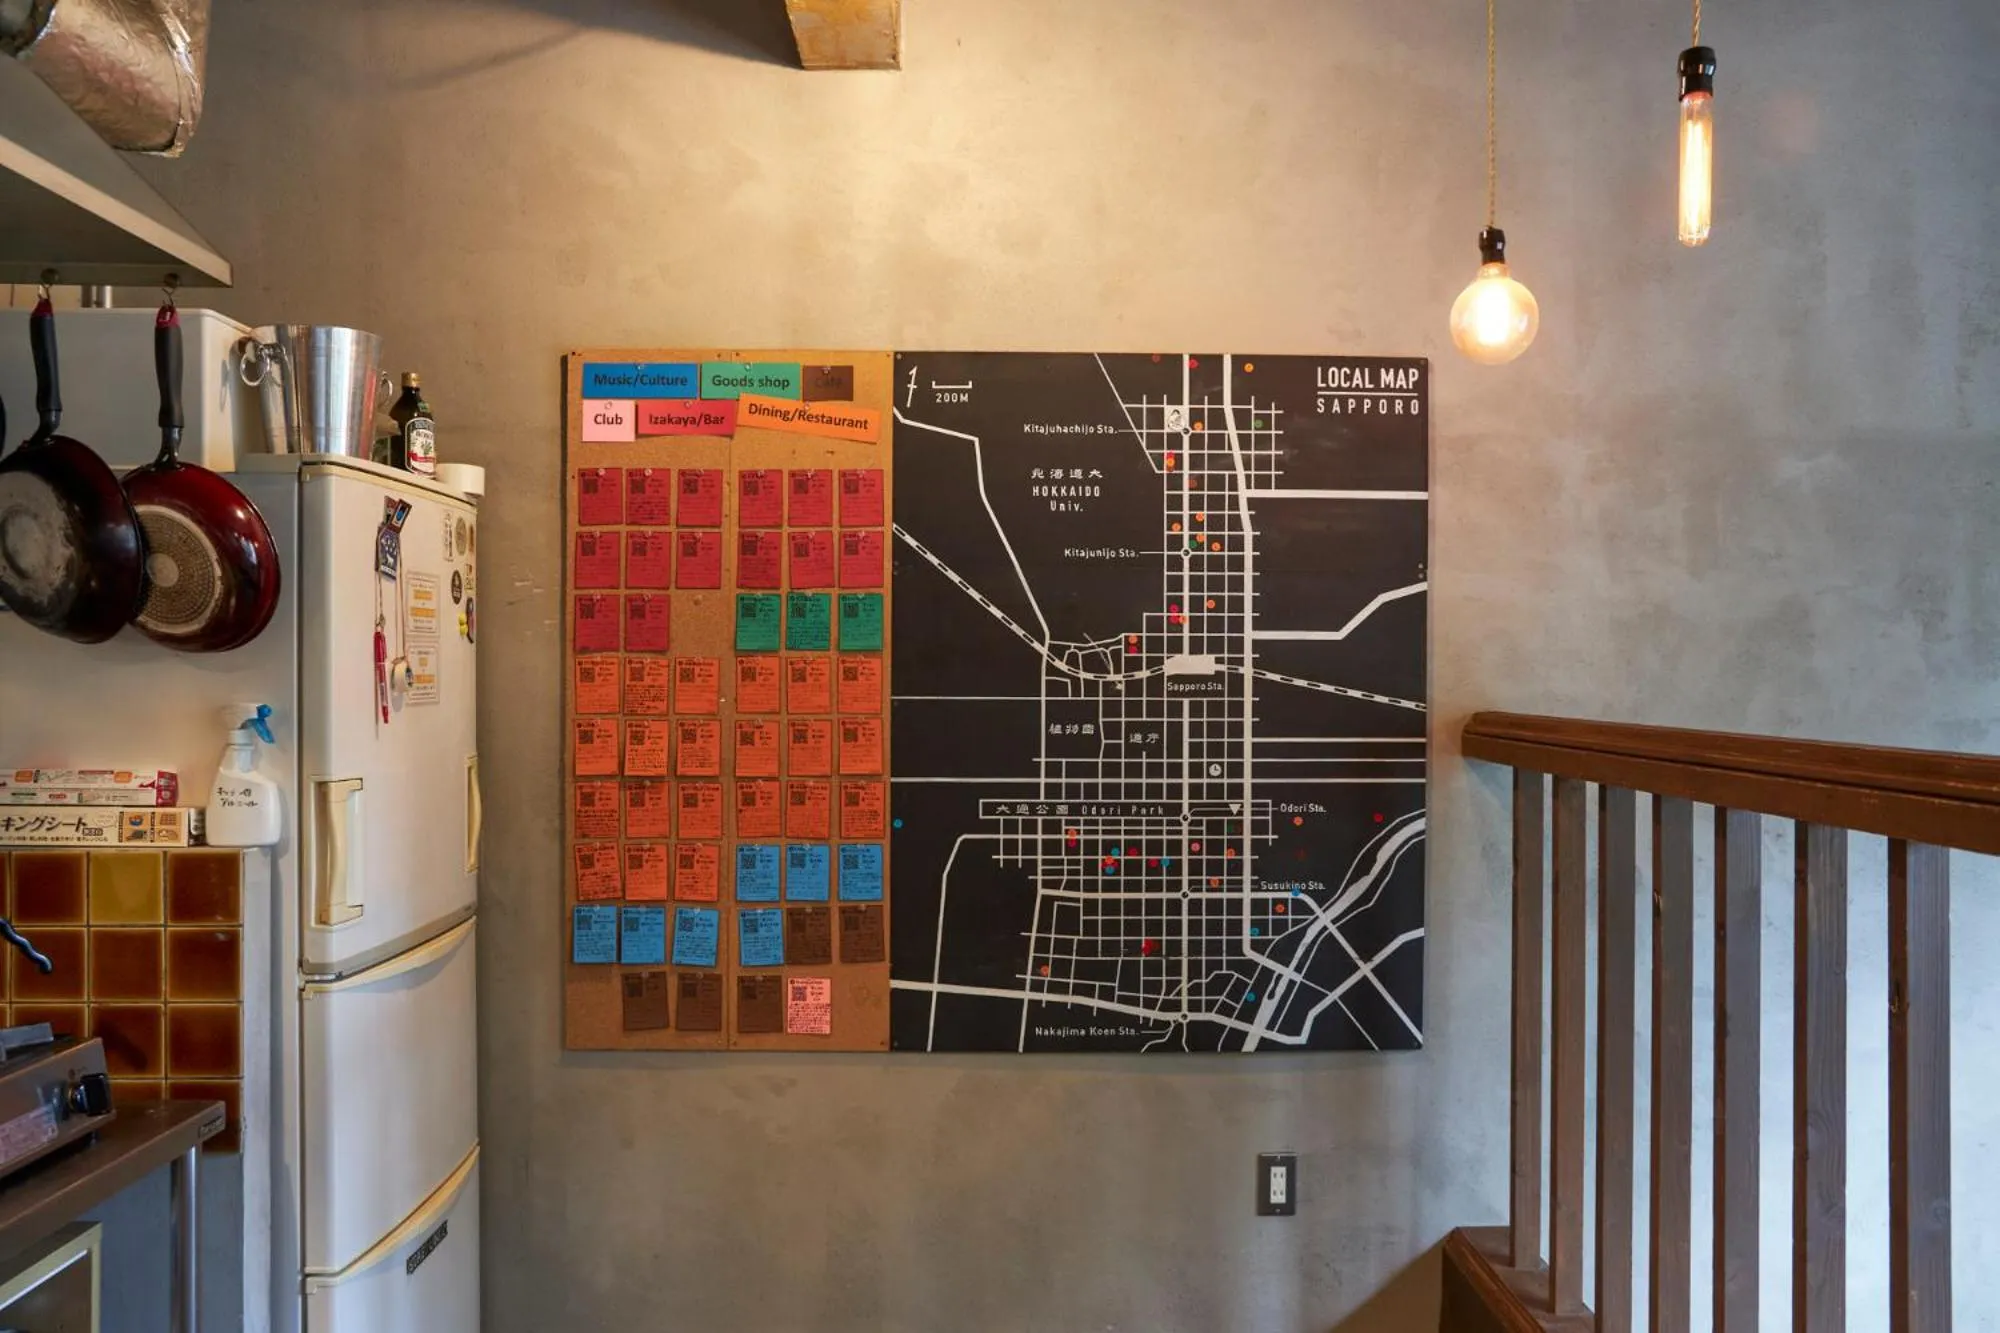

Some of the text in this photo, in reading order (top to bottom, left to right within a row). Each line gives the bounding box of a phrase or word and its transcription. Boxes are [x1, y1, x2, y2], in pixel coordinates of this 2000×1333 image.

[594, 373, 688, 387] Music/Culture
[711, 375, 790, 391] Goods shop
[1317, 367, 1419, 389] LOCAL MAP
[935, 392, 969, 404] 200M
[1316, 397, 1420, 415] SAPPORO
[593, 413, 623, 426] Club
[649, 413, 725, 428] Izakaya/Bar
[748, 403, 869, 431] Dining/Restaurant
[1023, 424, 1118, 435] Kitajuhachijo Sta.
[1032, 486, 1100, 497] HOKKAIDO
[1050, 500, 1084, 512] Univ.
[1119, 548, 1139, 558] Sta.
[1167, 682, 1225, 692] Sapporo Sta.
[1081, 804, 1121, 815] Odori
[1131, 804, 1165, 815] Park
[1280, 802, 1328, 813] Odori Sta.
[1308, 880, 1327, 890] Sta.
[1035, 1026, 1139, 1038] Nakajima Koen Sta.
